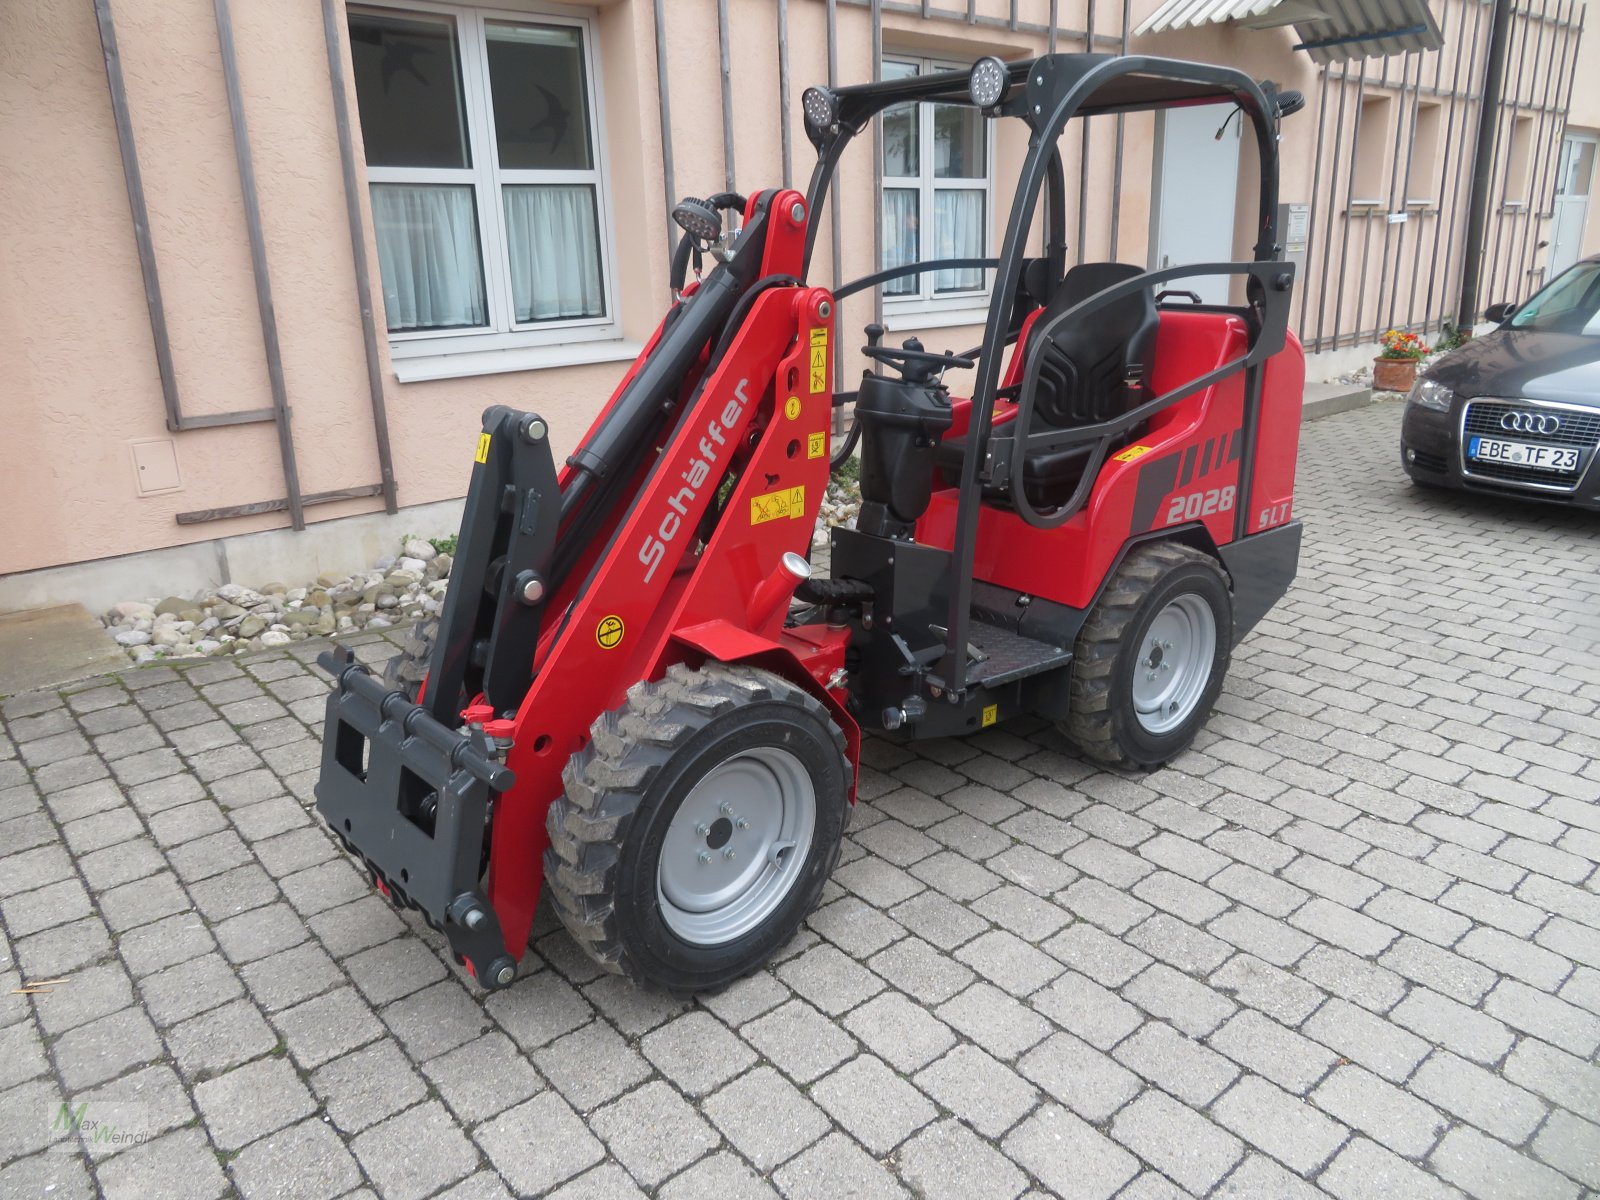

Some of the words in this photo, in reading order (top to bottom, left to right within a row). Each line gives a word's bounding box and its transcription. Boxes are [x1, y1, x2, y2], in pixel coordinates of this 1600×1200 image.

[1478, 440, 1512, 460] EBE
[1525, 446, 1549, 464] TF
[1551, 450, 1577, 468] 23
[638, 377, 750, 584] Schäffer
[1166, 485, 1236, 525] 2028
[1257, 502, 1290, 529] SLT
